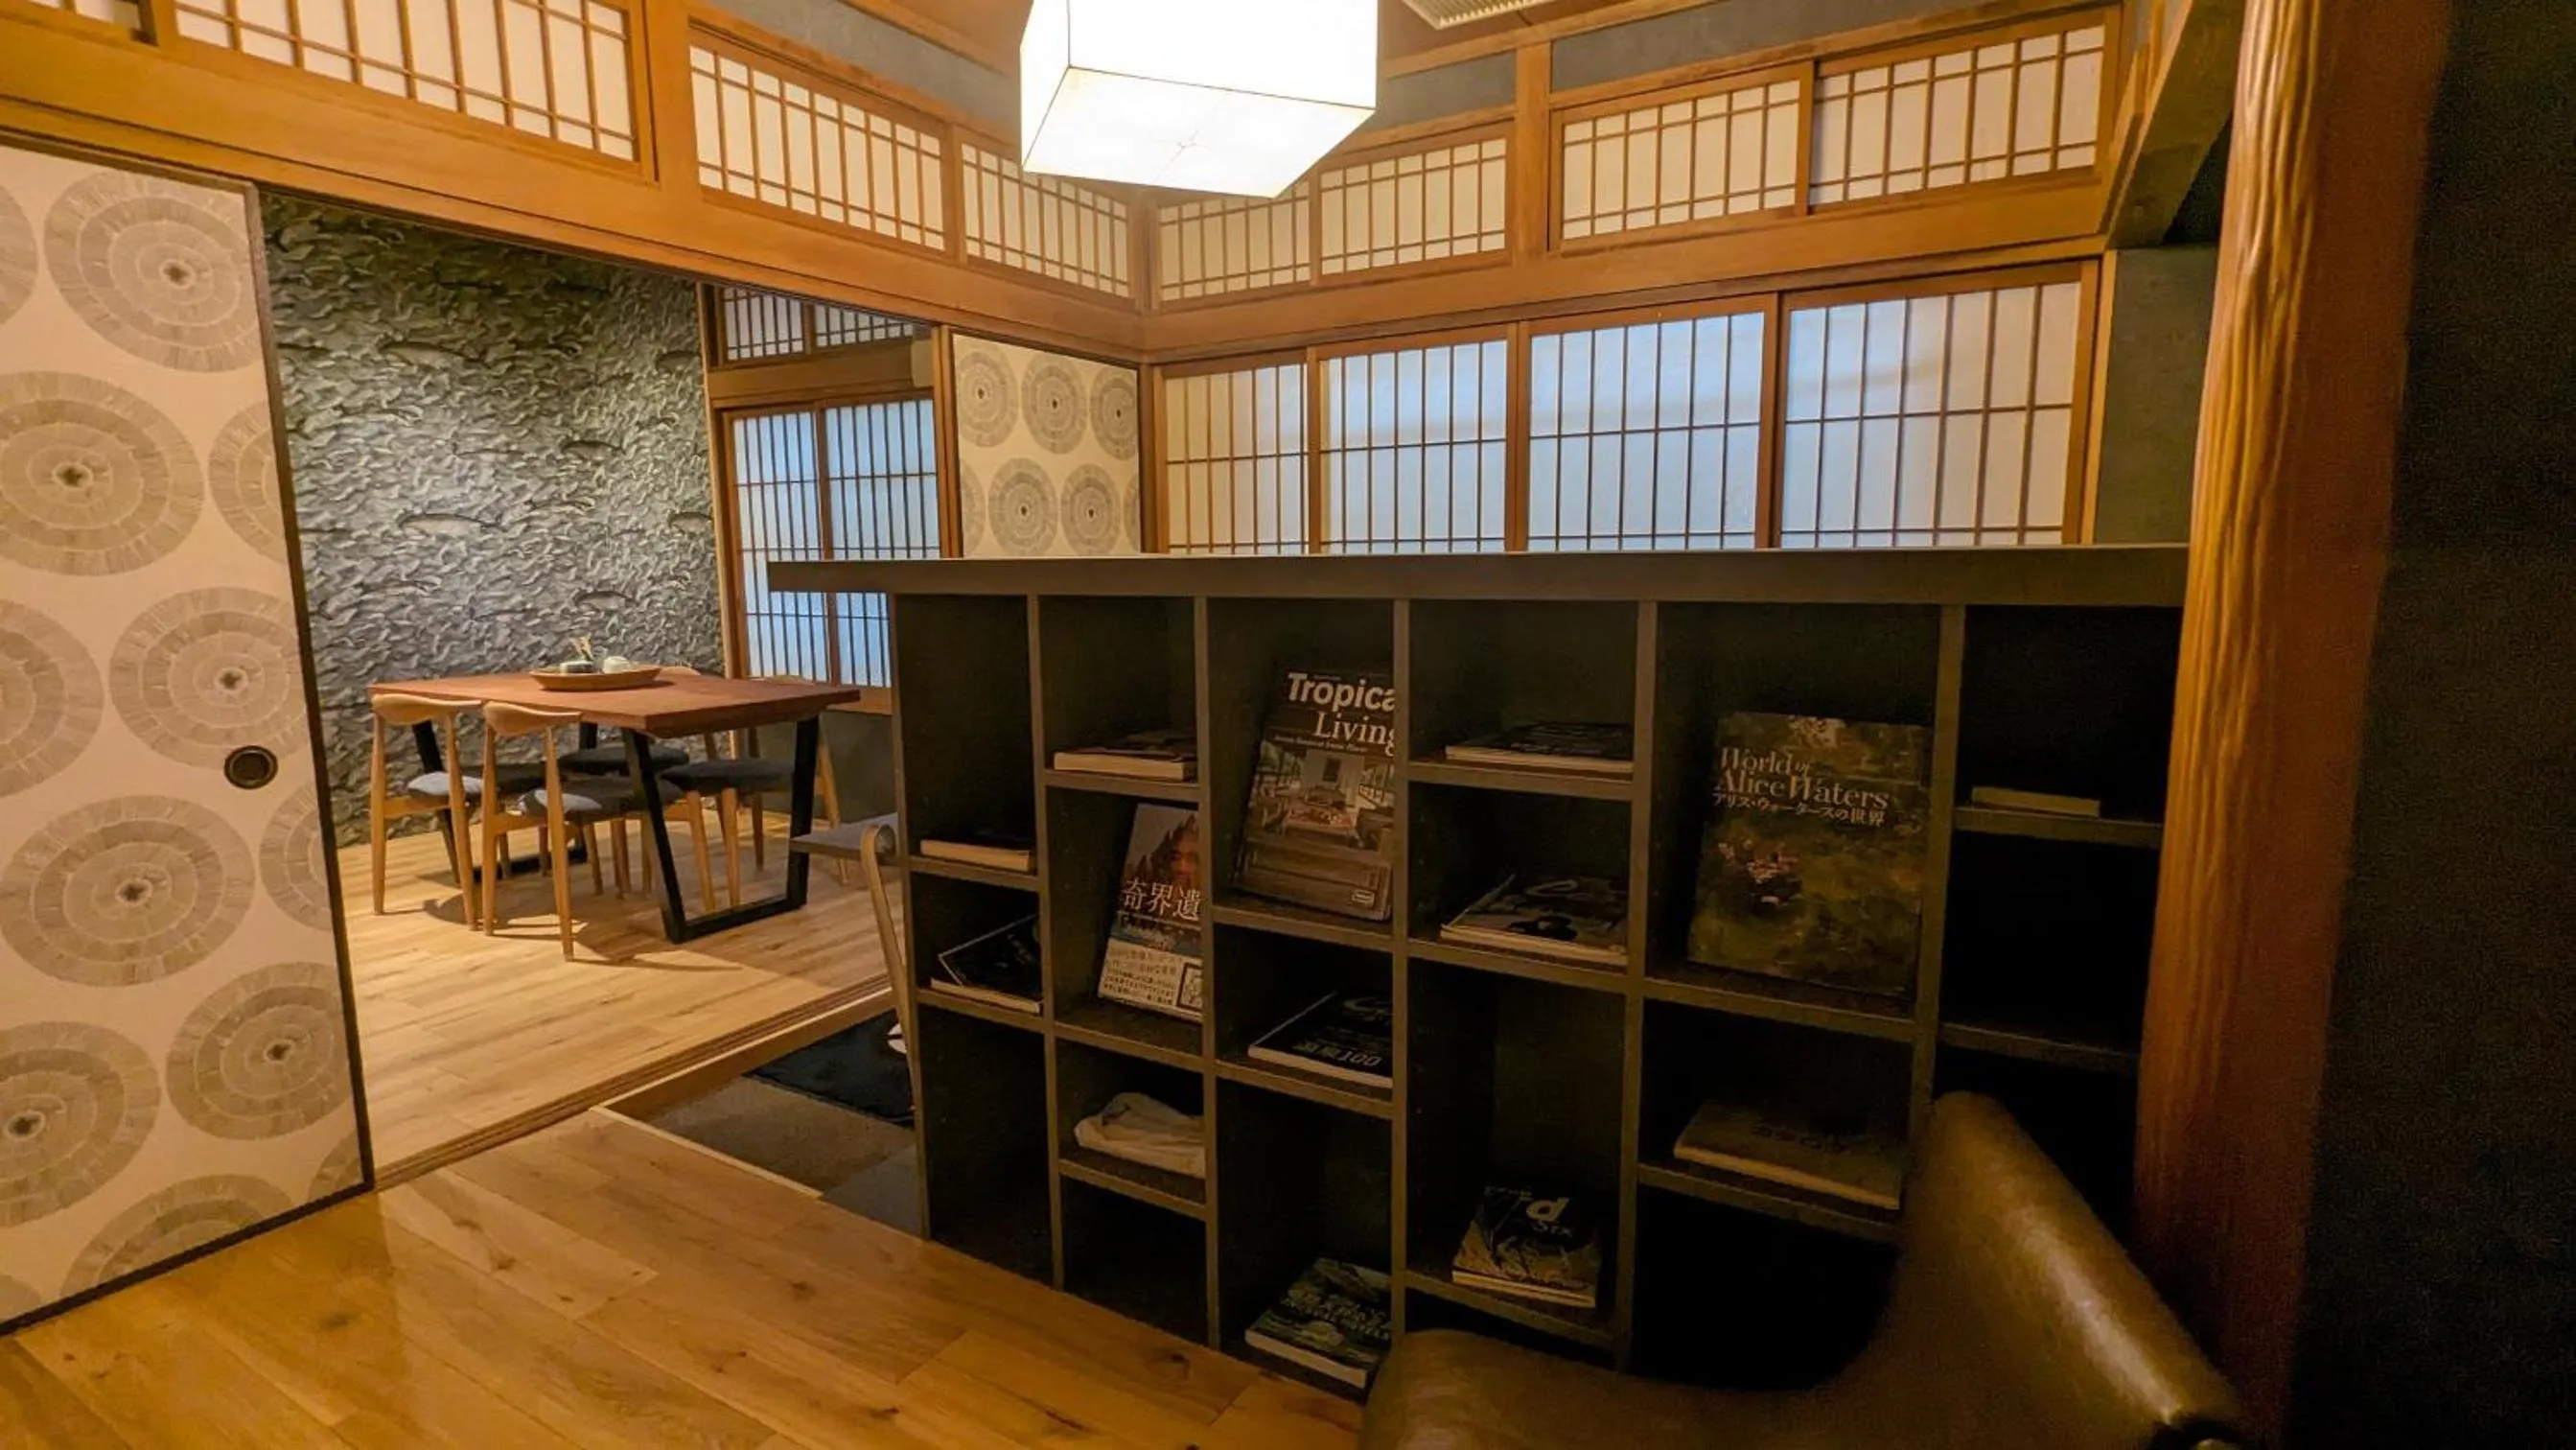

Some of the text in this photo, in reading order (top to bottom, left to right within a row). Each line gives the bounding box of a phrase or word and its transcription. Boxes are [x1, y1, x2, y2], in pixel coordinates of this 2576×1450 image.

[1721, 747, 1794, 776] World
[1712, 769, 1891, 810] Alice Waters
